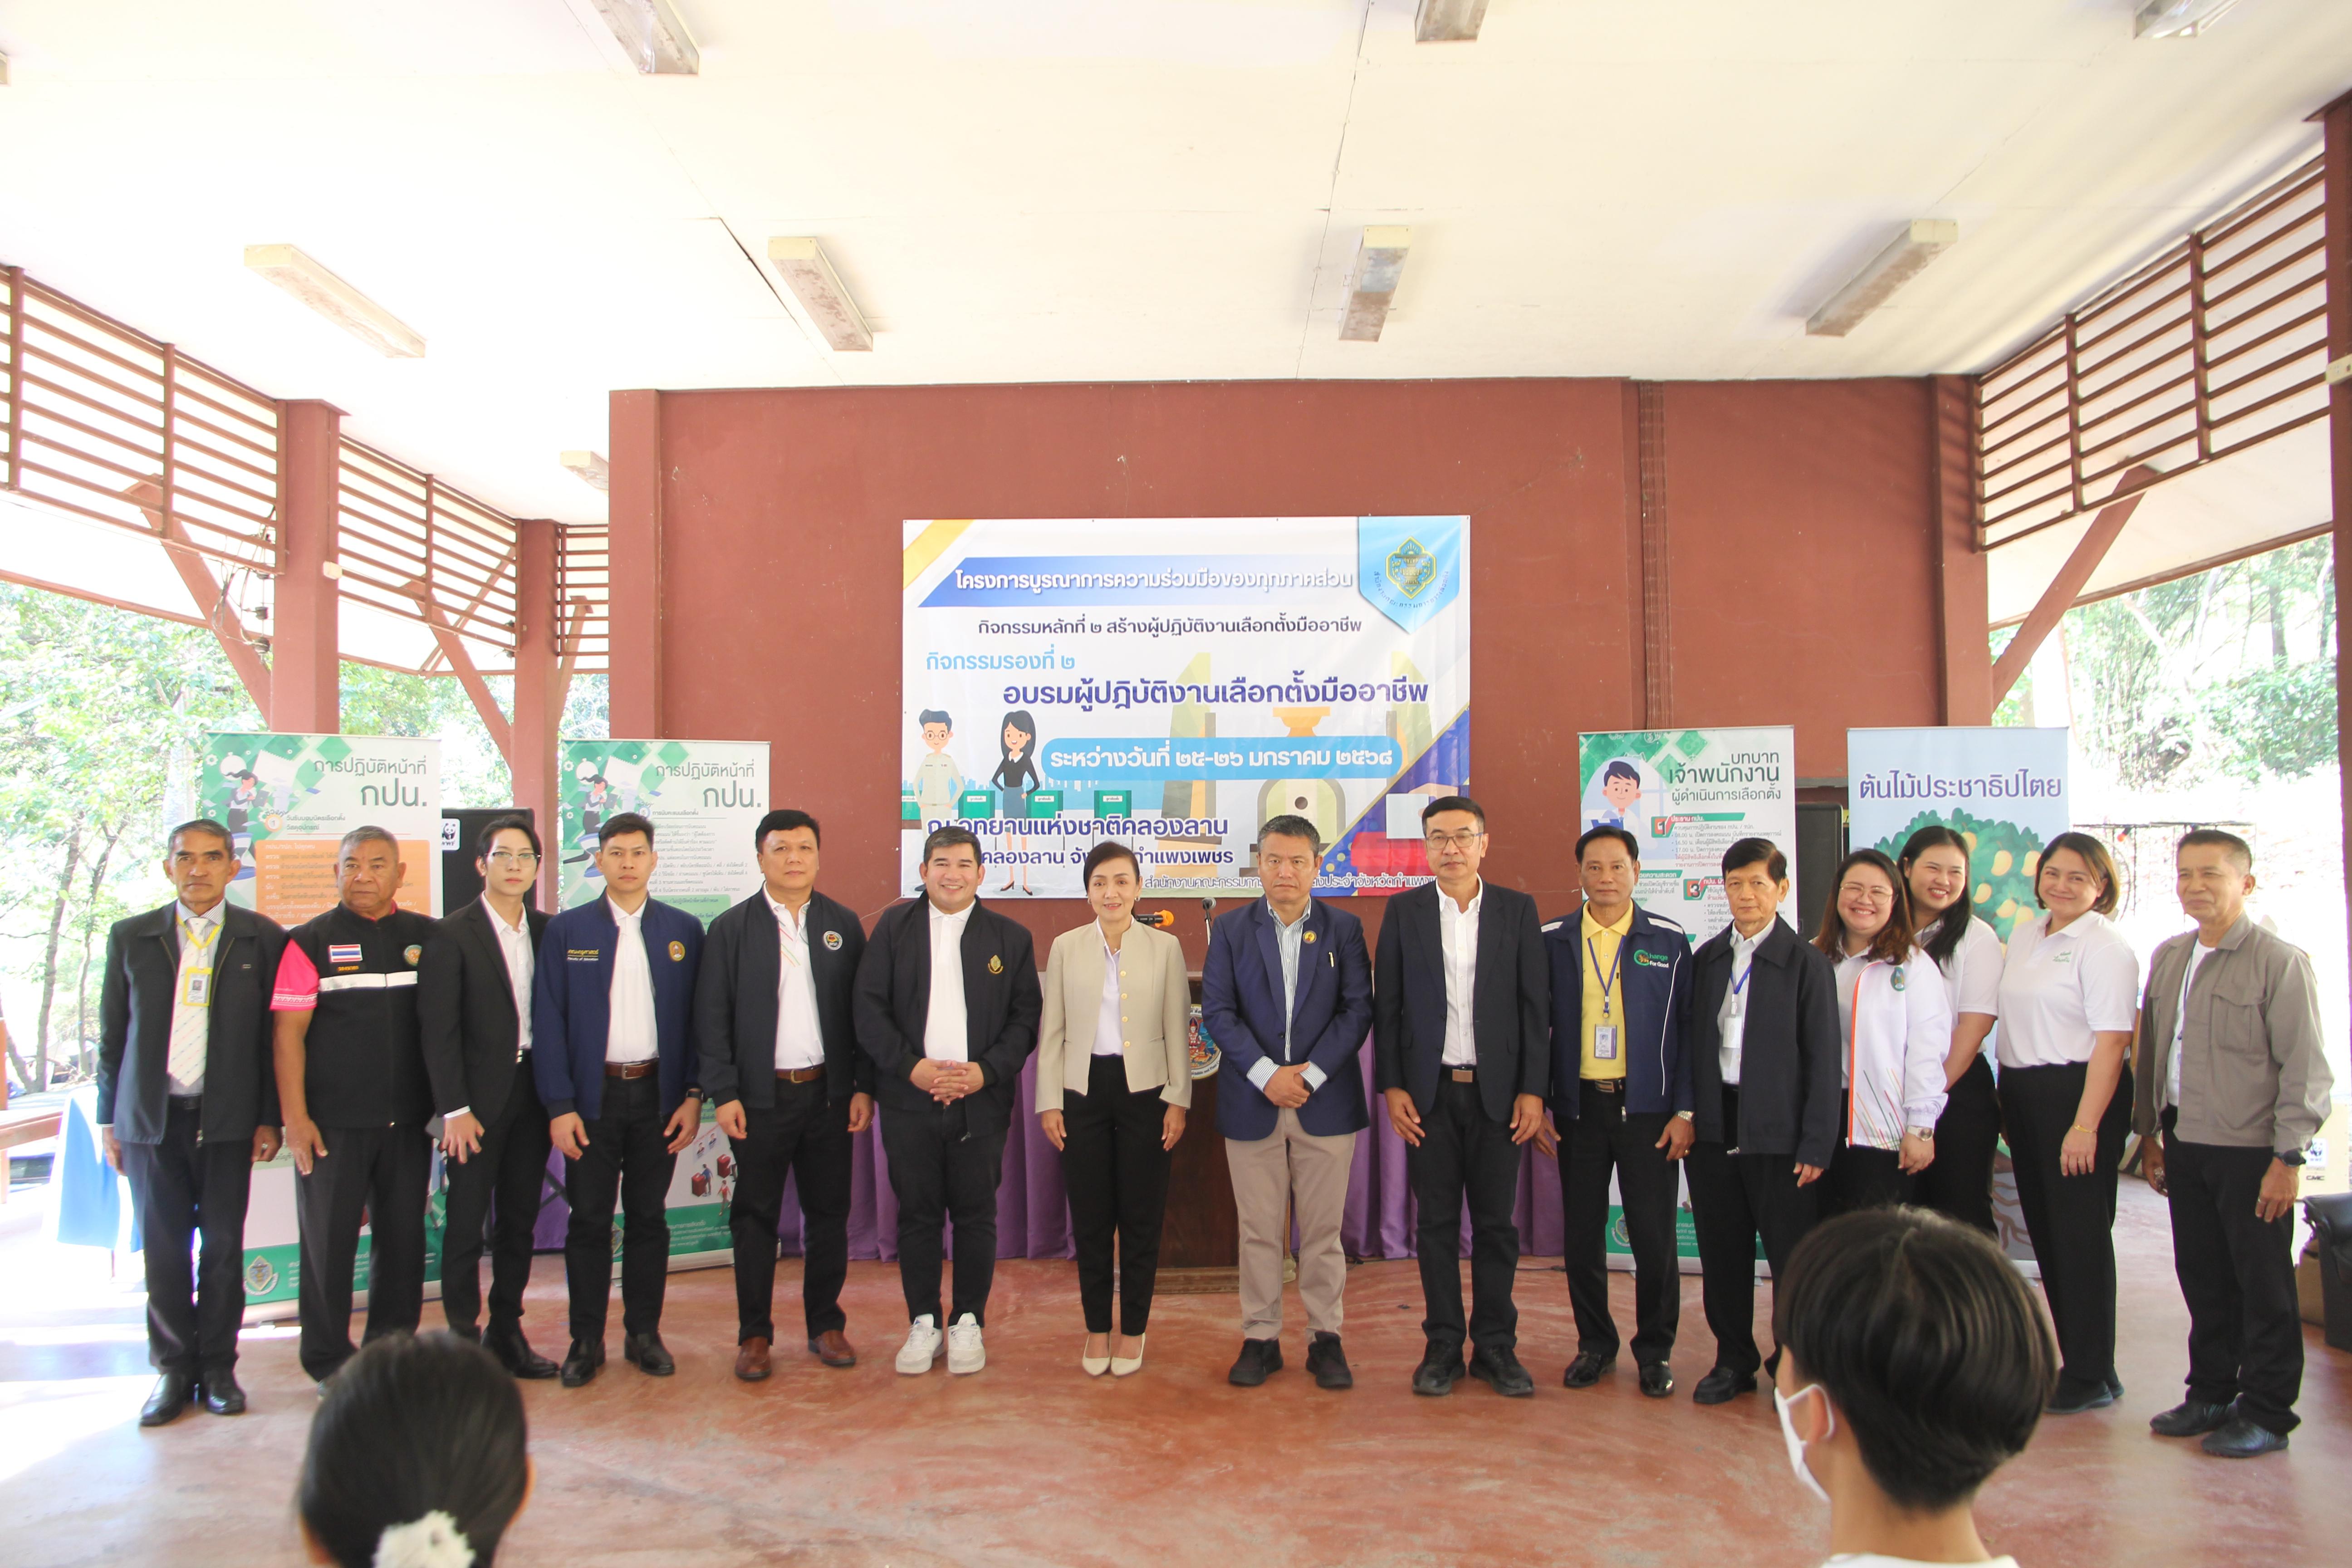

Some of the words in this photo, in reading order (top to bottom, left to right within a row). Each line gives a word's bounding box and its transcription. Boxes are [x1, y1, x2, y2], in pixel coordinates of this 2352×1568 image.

[956, 567, 1352, 594] โครงการบูรณาการความร่วมมือของทุกภาคส่วน
[978, 614, 1085, 633] กิจกรรมหลักที่
[1090, 622, 1101, 633] ๒
[1107, 612, 1362, 637] สร้างผู้ปฏิบัติงานเลือกตั้งมืออาชีพ
[927, 644, 1054, 670] กิจกรรมรองที่
[1061, 655, 1075, 669] ๒
[314, 755, 427, 776] การปฏิบัติหน้าที่
[1051, 740, 1170, 767] ระหว่างวันที่
[1176, 751, 1244, 766] ๒๕-๒๖
[1250, 750, 1330, 766] มกราคม
[1336, 750, 1393, 765] ๒๕๖๘
[1731, 751, 1779, 764] บทบาท
[656, 759, 755, 780] การปฏิบัติหน้าที่
[1669, 763, 1780, 784] เจ้าพนักงาน
[362, 778, 428, 807] กปน.
[703, 780, 762, 808] กปน.
[1672, 783, 1781, 806] ผู้ดำเนินการเลือกตั้ง
[1860, 769, 2062, 799] ต้นไม้ประชาธิปไตย
[1690, 884, 1700, 898] 3
[1634, 949, 1668, 966] Change
